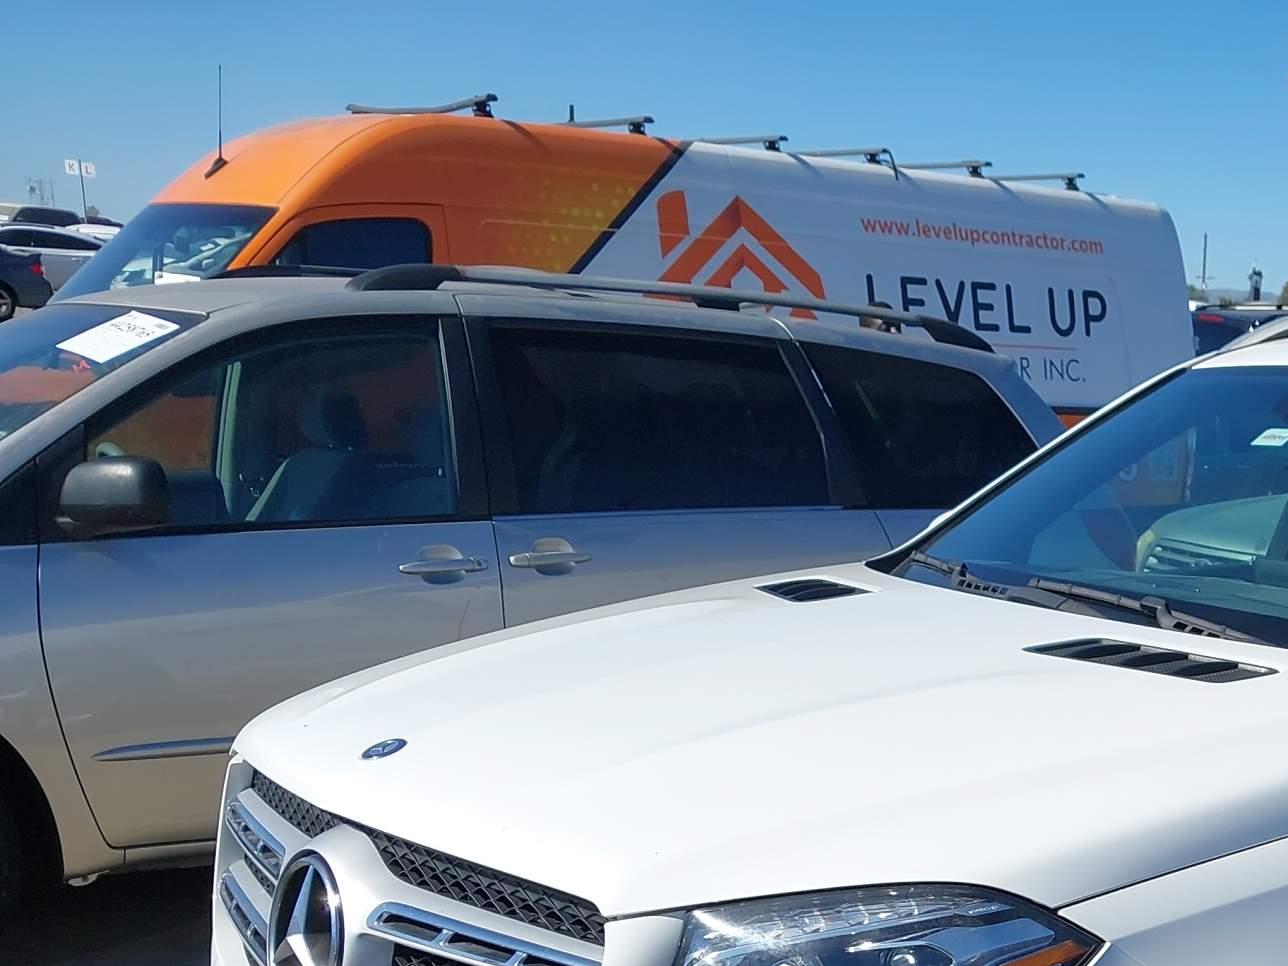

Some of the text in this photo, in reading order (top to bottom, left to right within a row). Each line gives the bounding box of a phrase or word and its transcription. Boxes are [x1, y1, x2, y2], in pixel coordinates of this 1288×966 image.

[860, 217, 1104, 255] www.levelupcontractor.com
[865, 273, 1107, 337] LEVEL UP
[1043, 357, 1086, 382] INC.
